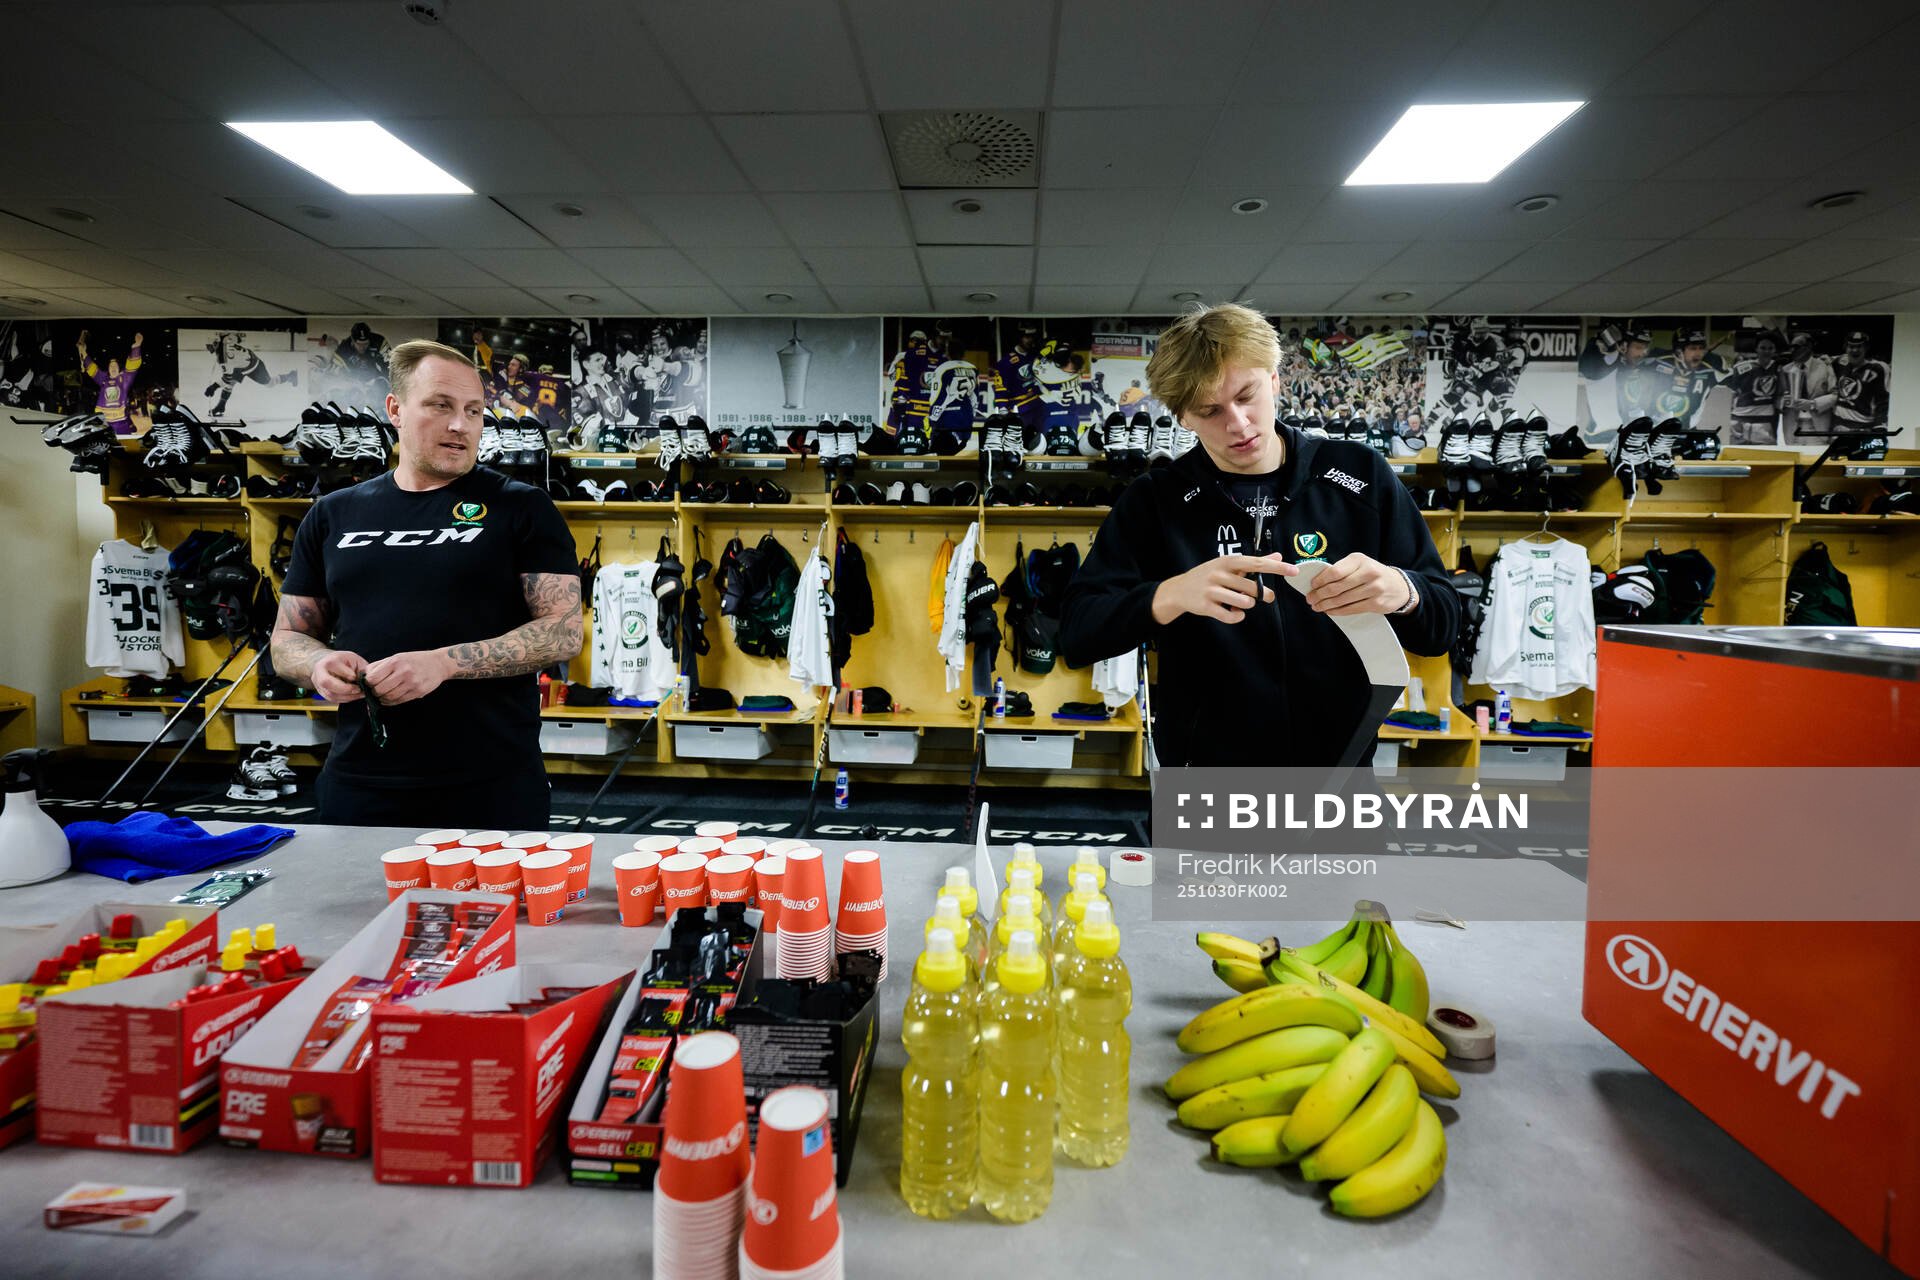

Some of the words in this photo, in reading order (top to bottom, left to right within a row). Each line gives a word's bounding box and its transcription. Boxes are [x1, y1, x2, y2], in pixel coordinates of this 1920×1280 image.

[749, 413, 773, 423] 1986
[782, 413, 806, 423] 1988
[336, 528, 485, 549] CCM
[107, 565, 141, 577] Svema
[110, 583, 161, 632] 39
[114, 634, 161, 643] OCKE
[125, 643, 162, 651] STOR
[174, 804, 316, 816] CCM
[549, 814, 627, 826] CM
[990, 828, 1128, 842] CCM
[568, 863, 588, 873] ERVIT
[1662, 968, 1861, 1120] ENERVIT
[226, 1090, 267, 1115] PRE
